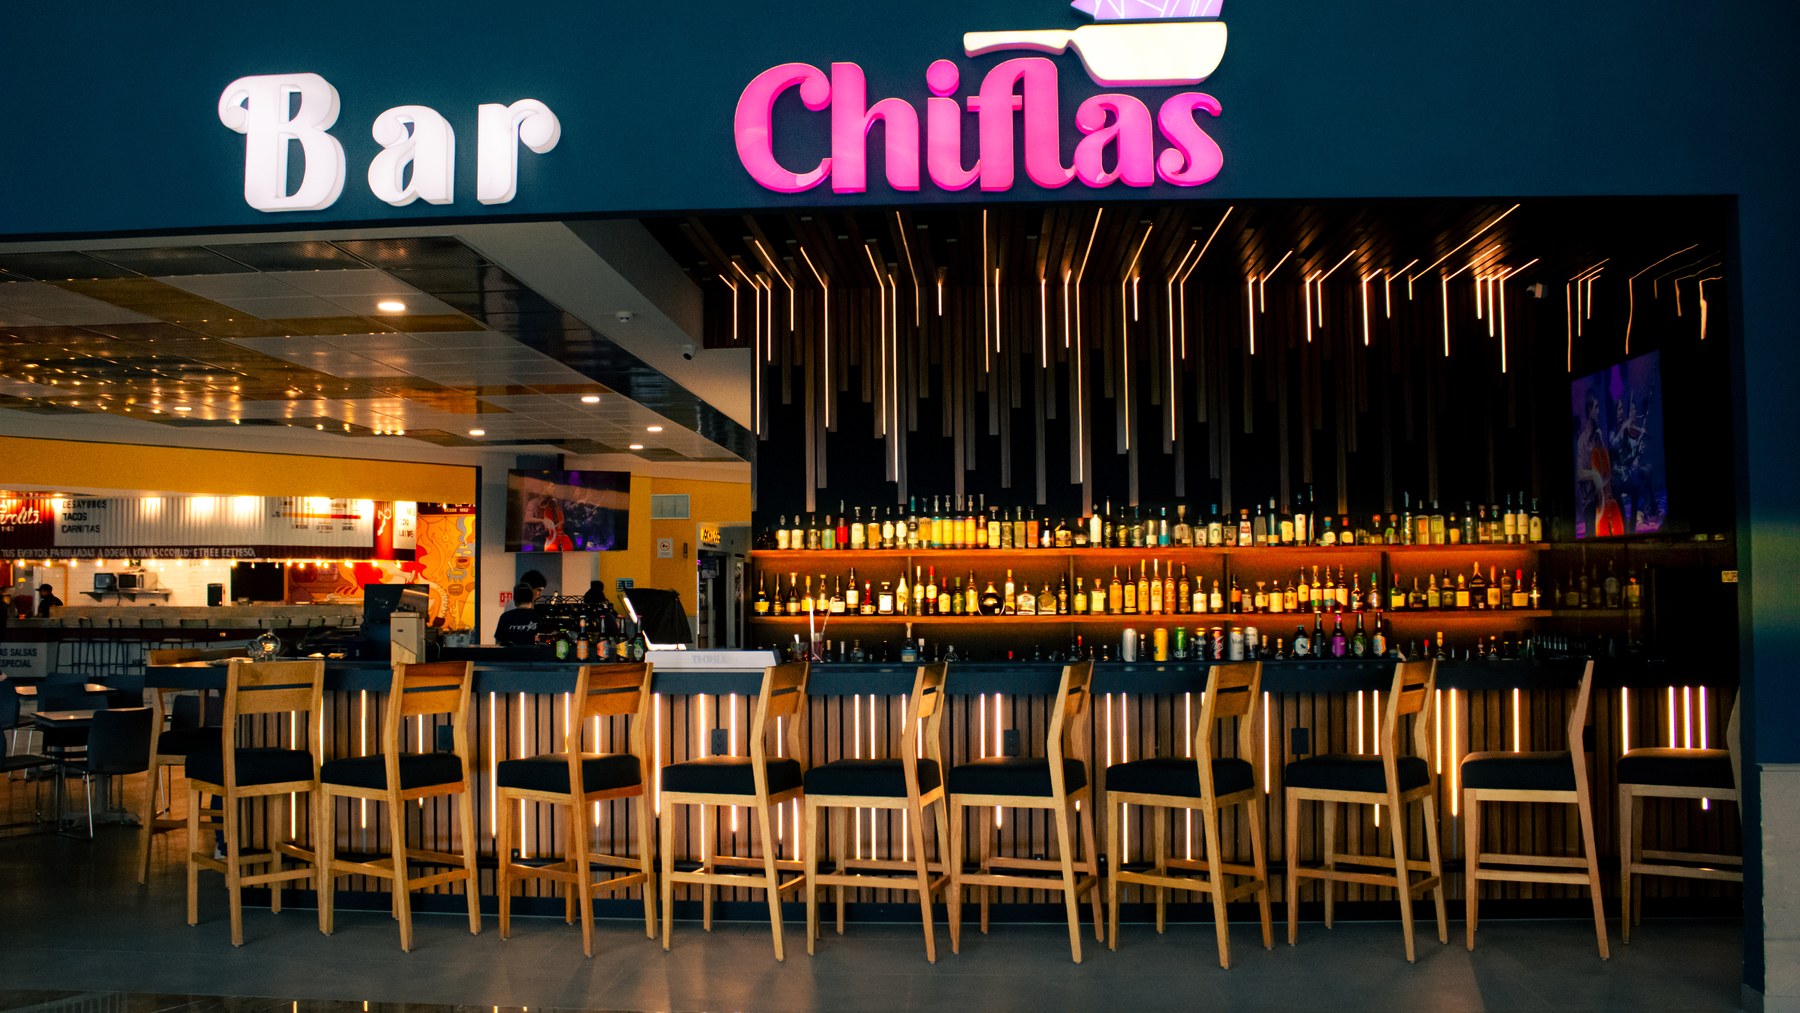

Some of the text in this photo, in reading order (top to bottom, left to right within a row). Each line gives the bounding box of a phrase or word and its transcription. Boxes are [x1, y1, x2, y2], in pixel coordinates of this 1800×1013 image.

[734, 57, 1224, 194] Chiflas
[218, 72, 561, 213] Bar
[62, 512, 88, 521] TACOS
[61, 524, 101, 534] CARNITAS
[9, 647, 38, 657] SALSAS
[0, 659, 32, 668] SPECIAL
